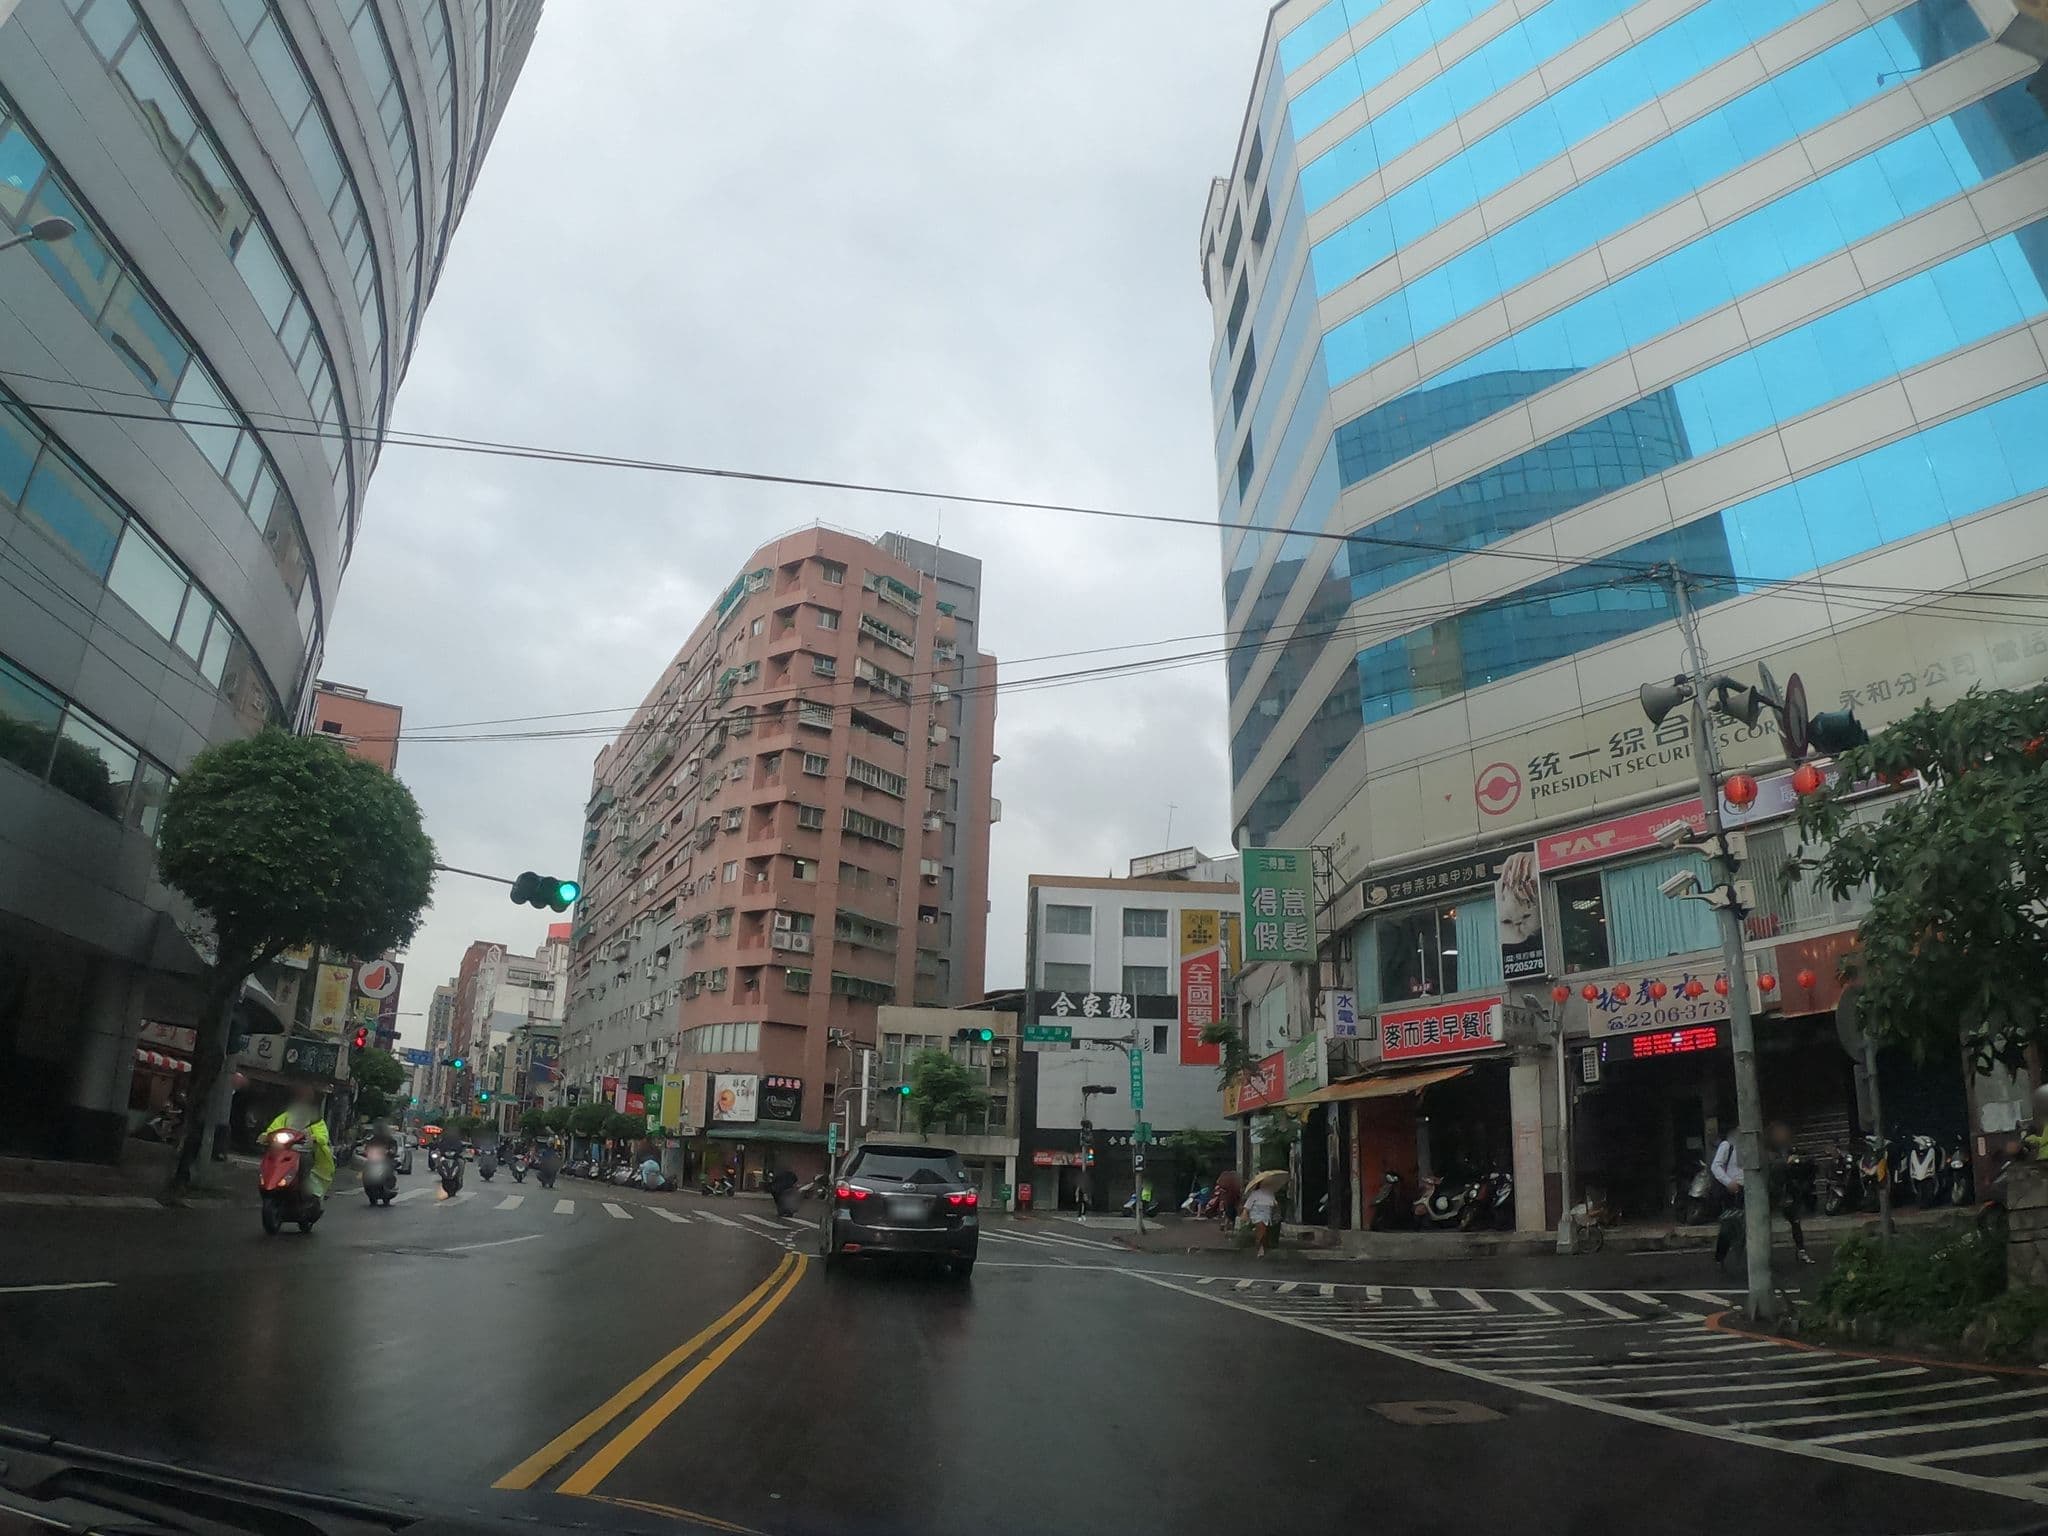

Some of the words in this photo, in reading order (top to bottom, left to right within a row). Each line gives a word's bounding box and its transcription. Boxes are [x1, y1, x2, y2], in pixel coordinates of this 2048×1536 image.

[1840, 653, 1976, 709] 永和分公司
[1531, 763, 1622, 800] PRESIDENT
[1626, 733, 1730, 774] SECURIS
[1734, 720, 1777, 743] COR
[1550, 829, 1616, 858] TAT
[1251, 887, 1307, 917] 得意
[1252, 921, 1308, 953] 假髮
[1504, 958, 1544, 974] 29205278
[1051, 992, 1132, 1020] 合家歡
[1627, 999, 1727, 1029] 2206-373
[1135, 1154, 1144, 1166] P
